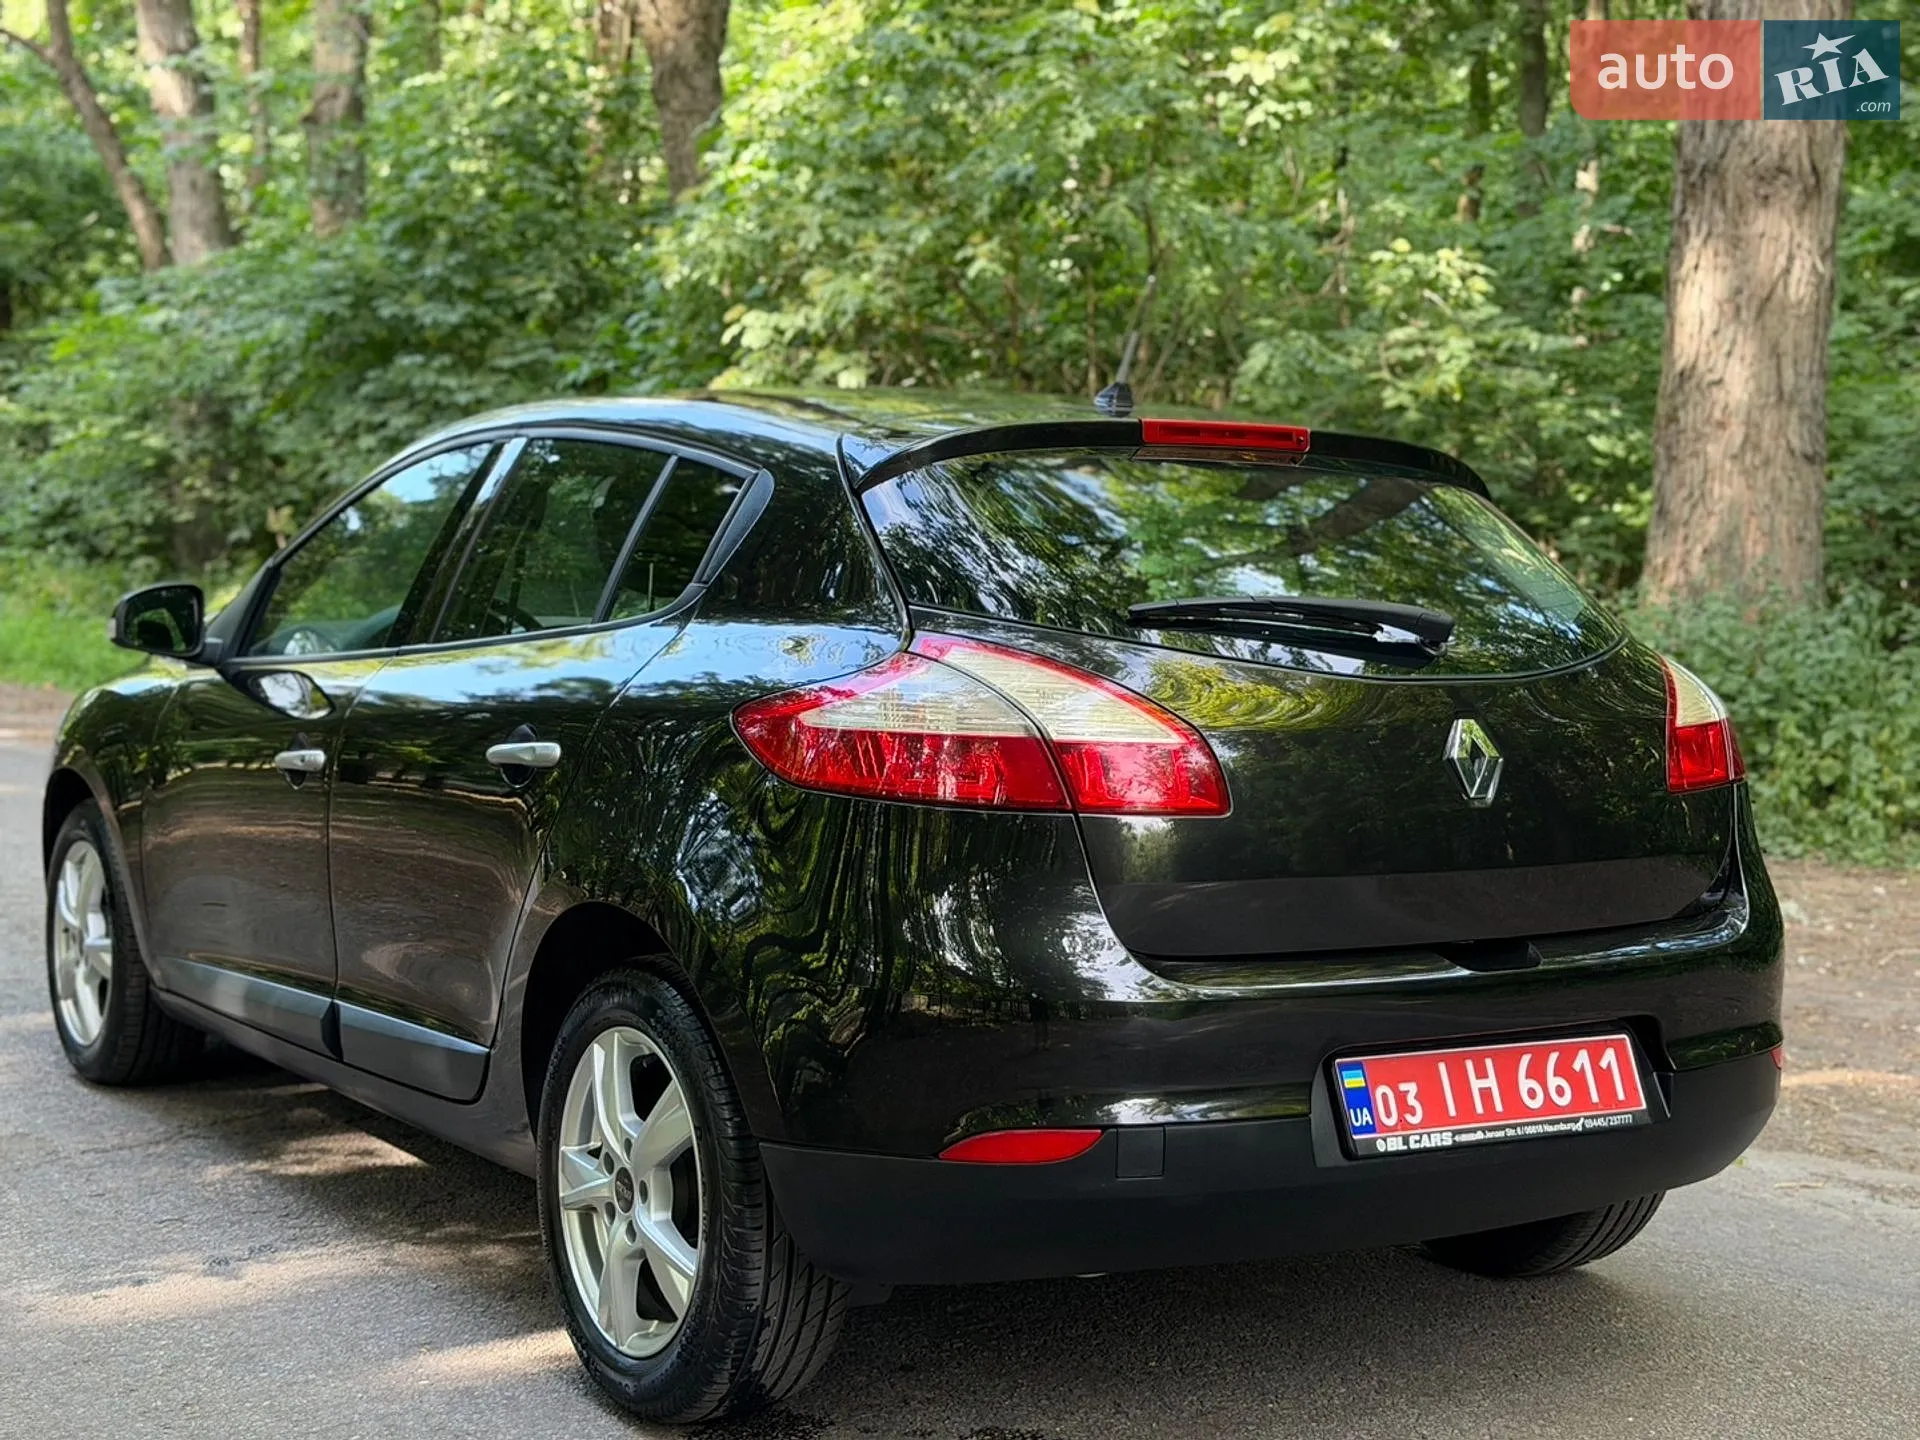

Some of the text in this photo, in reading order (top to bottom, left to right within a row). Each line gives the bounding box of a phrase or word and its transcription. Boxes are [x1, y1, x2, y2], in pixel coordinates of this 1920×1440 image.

[1375, 1047, 1625, 1127] 03 IH 6611
[1351, 1107, 1374, 1127] UA
[1409, 1131, 1453, 1149] CARS
